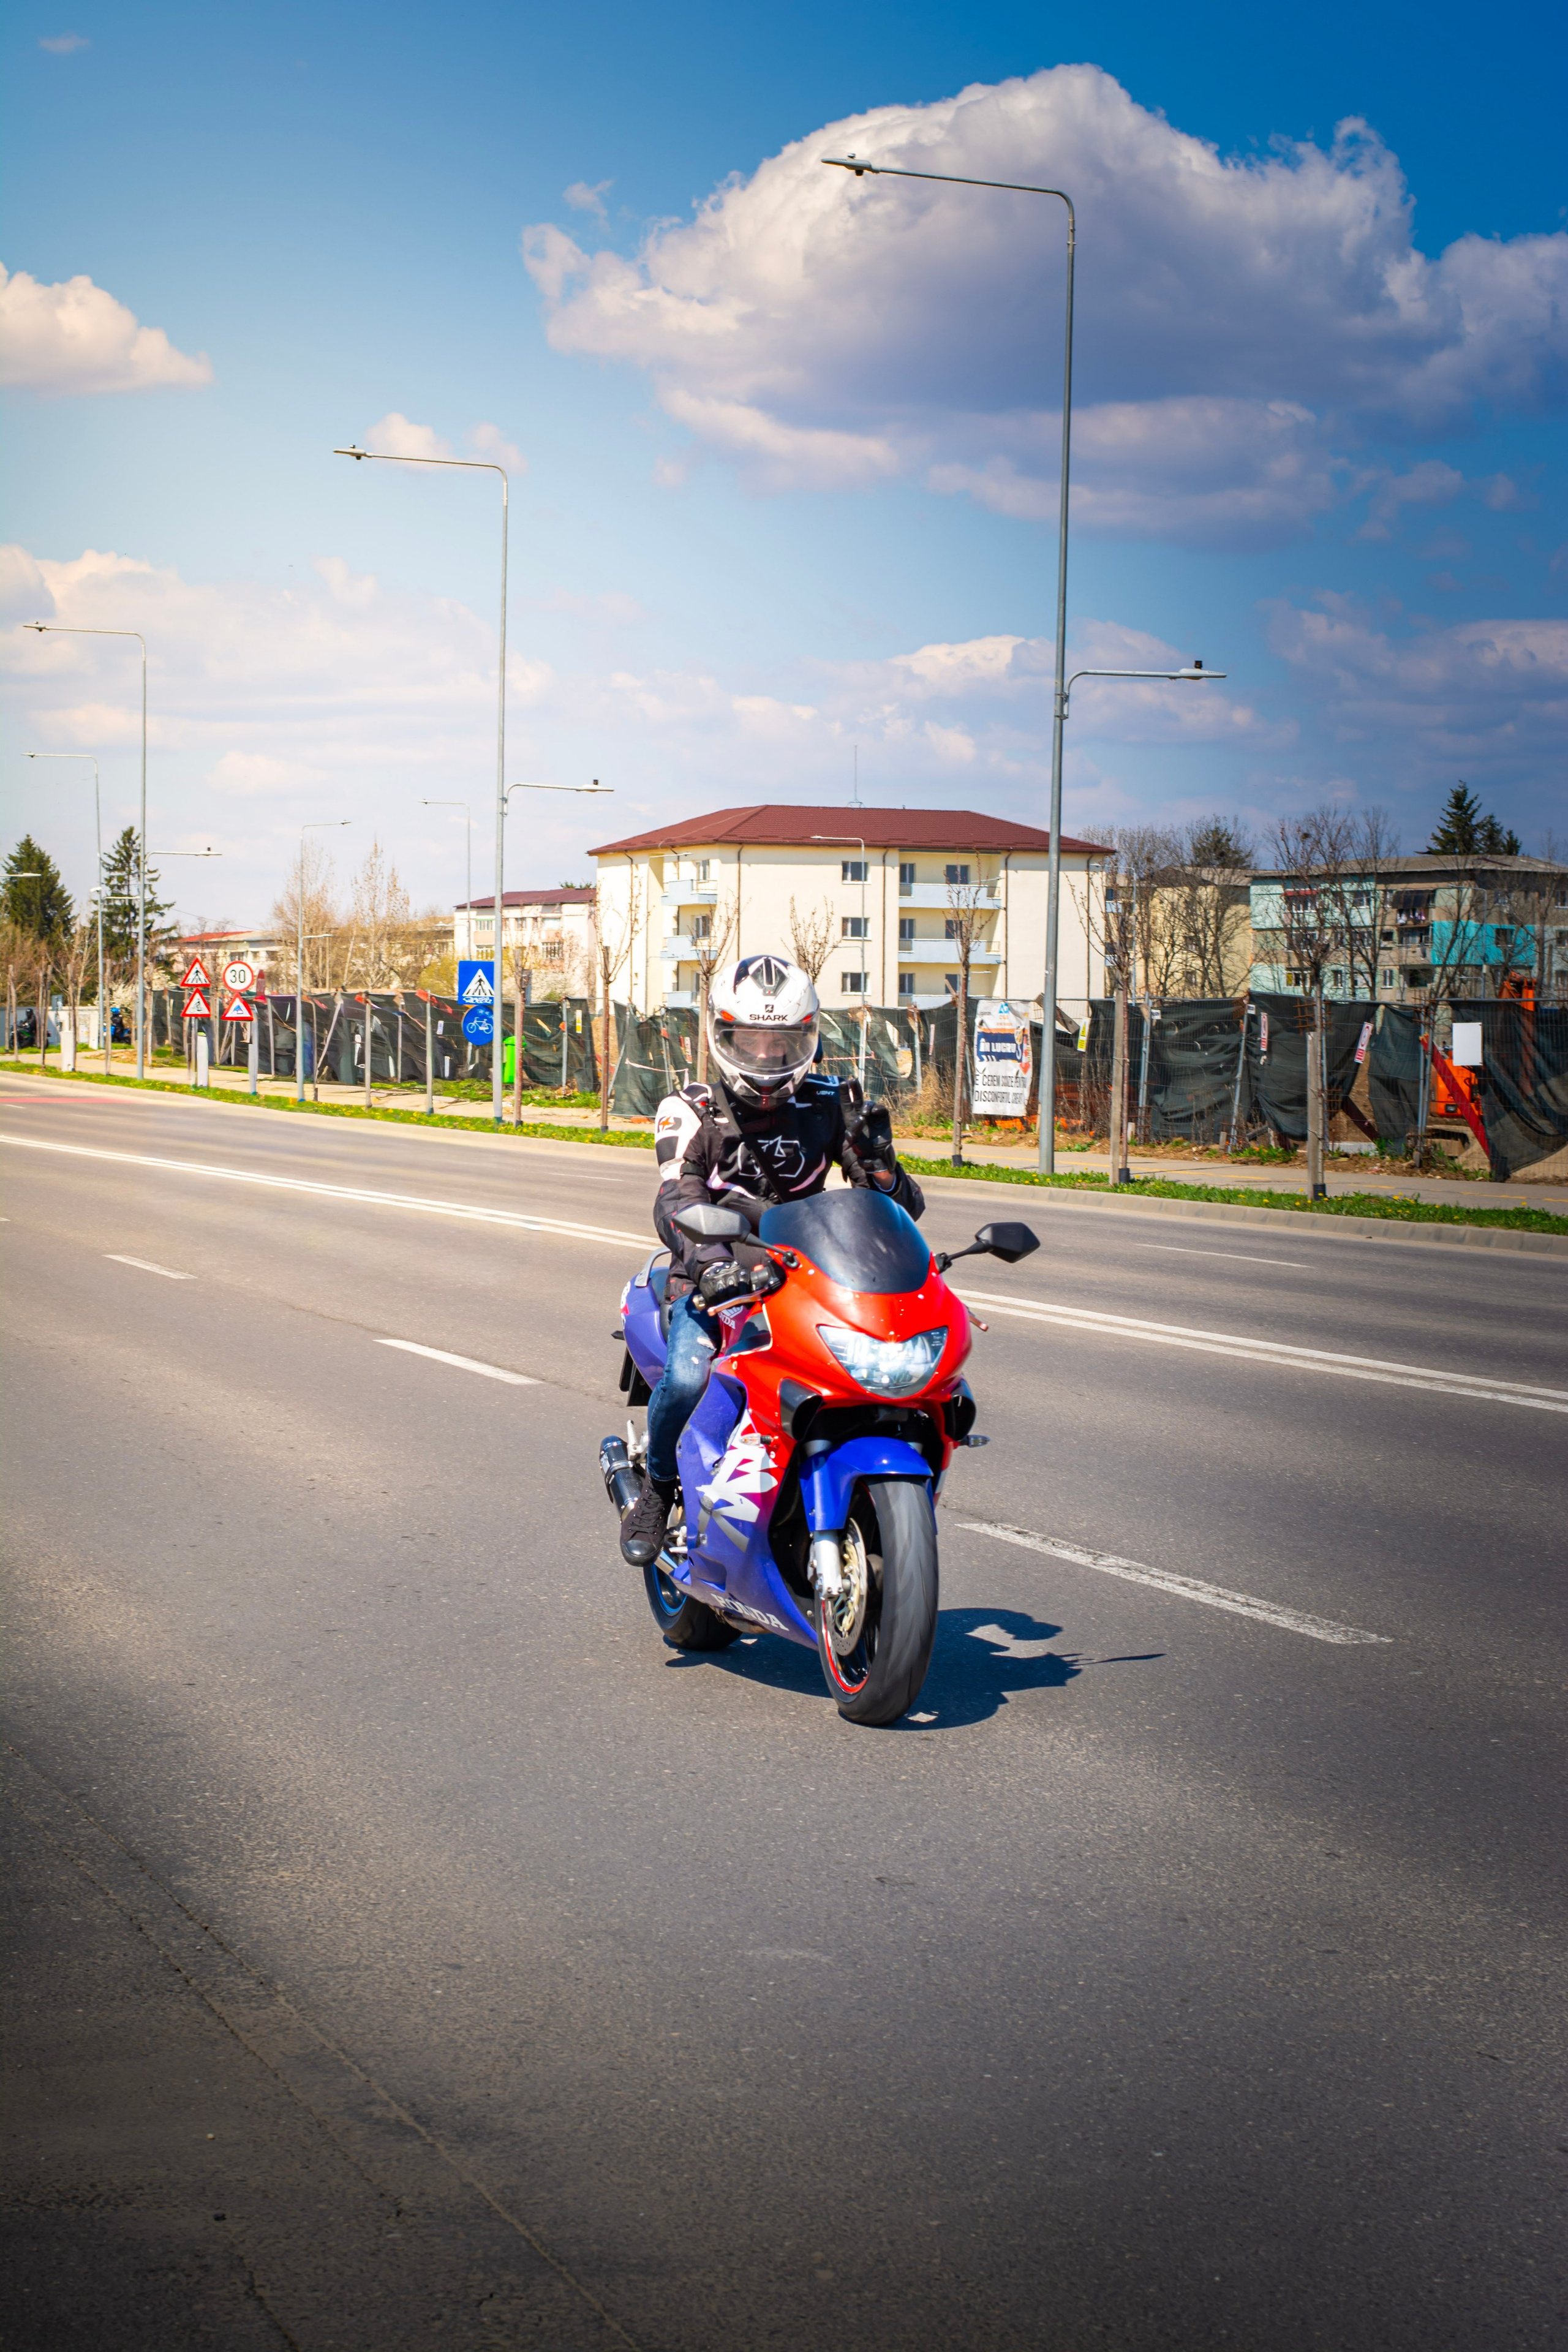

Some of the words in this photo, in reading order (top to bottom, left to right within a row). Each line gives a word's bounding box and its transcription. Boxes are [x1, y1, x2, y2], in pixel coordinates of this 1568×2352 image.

[230, 970, 246, 983] 30
[717, 1312, 736, 1330] NDA
[710, 1593, 790, 1631] HONDA
